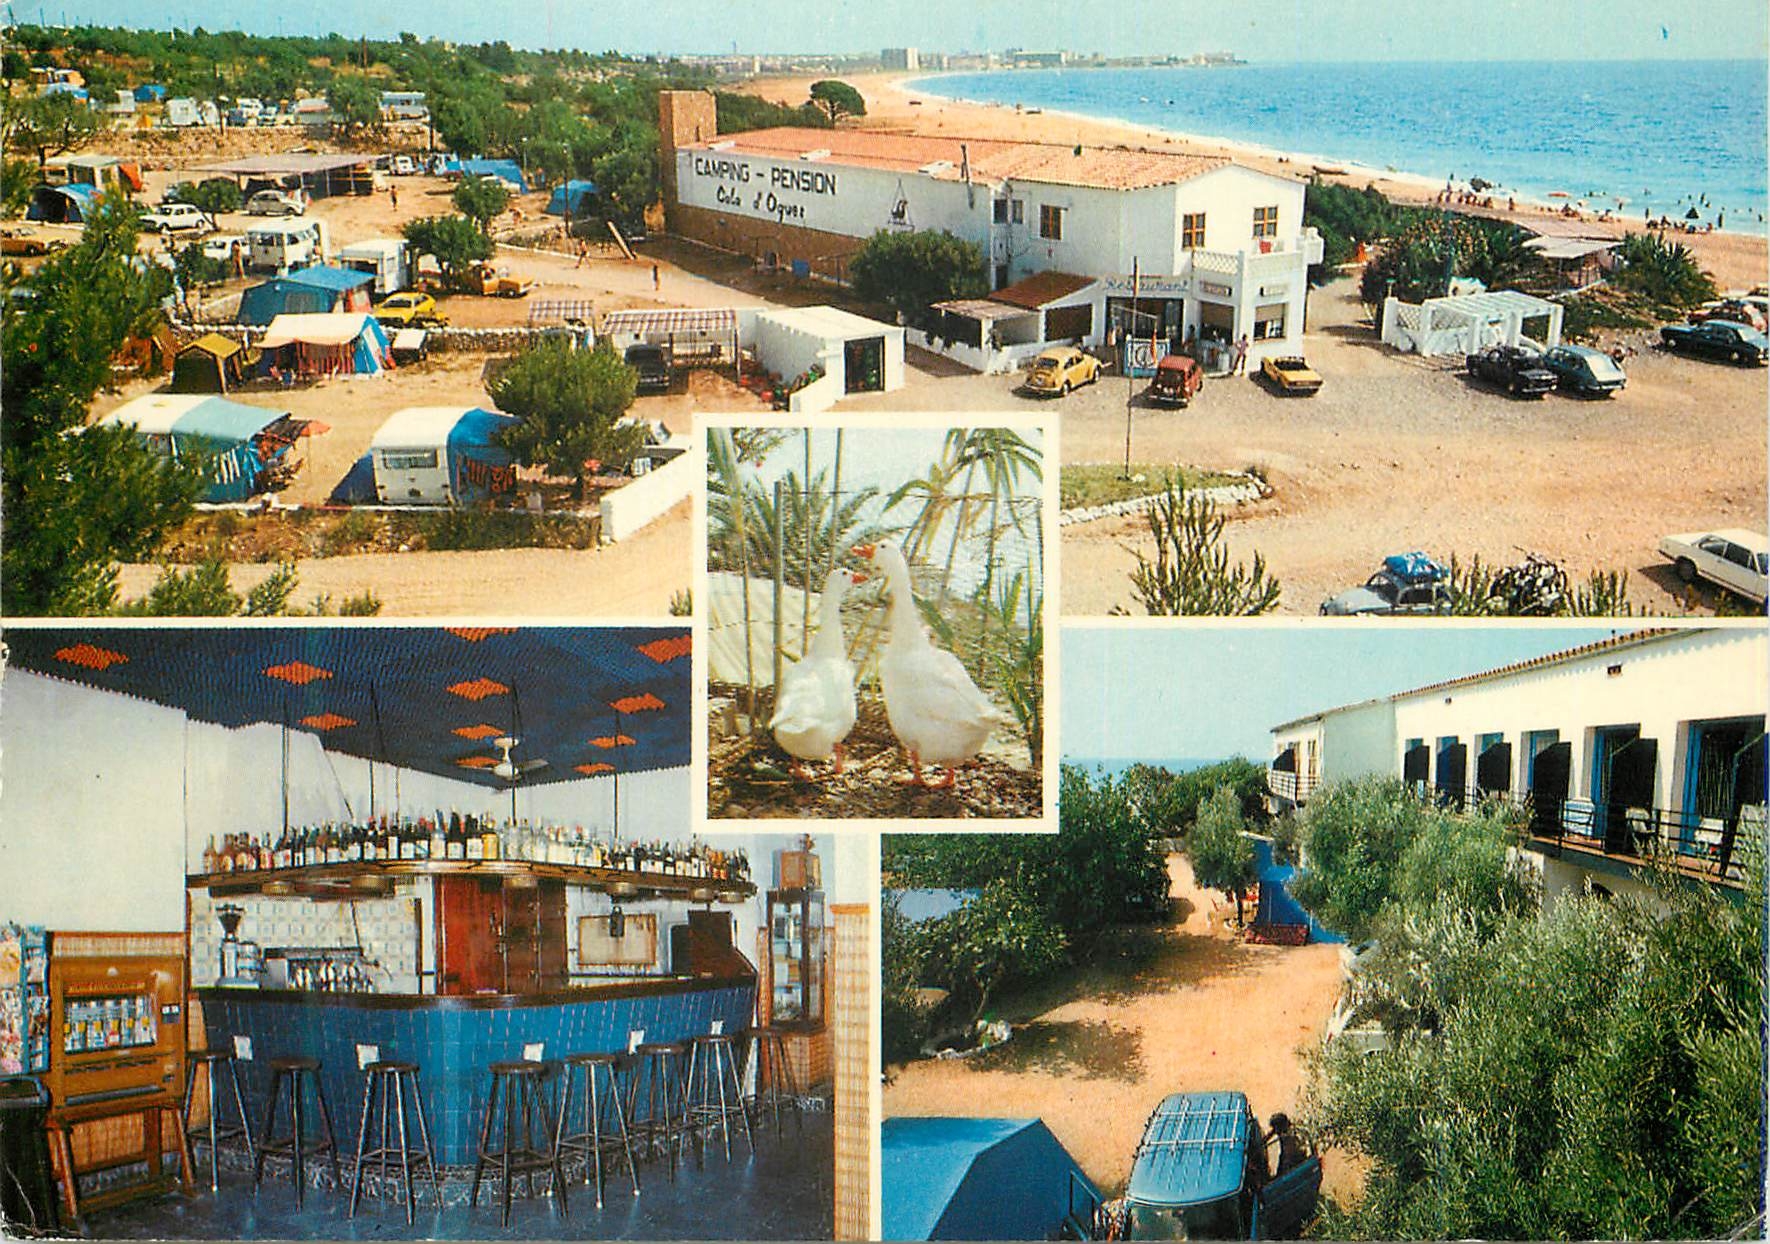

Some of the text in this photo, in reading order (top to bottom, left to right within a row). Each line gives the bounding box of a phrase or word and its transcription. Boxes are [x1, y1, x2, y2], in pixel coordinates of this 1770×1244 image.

[695, 157, 750, 183] CAMPING
[770, 166, 836, 196] PENSION
[717, 185, 741, 206] Cala
[1103, 276, 1189, 292] Resaurant
